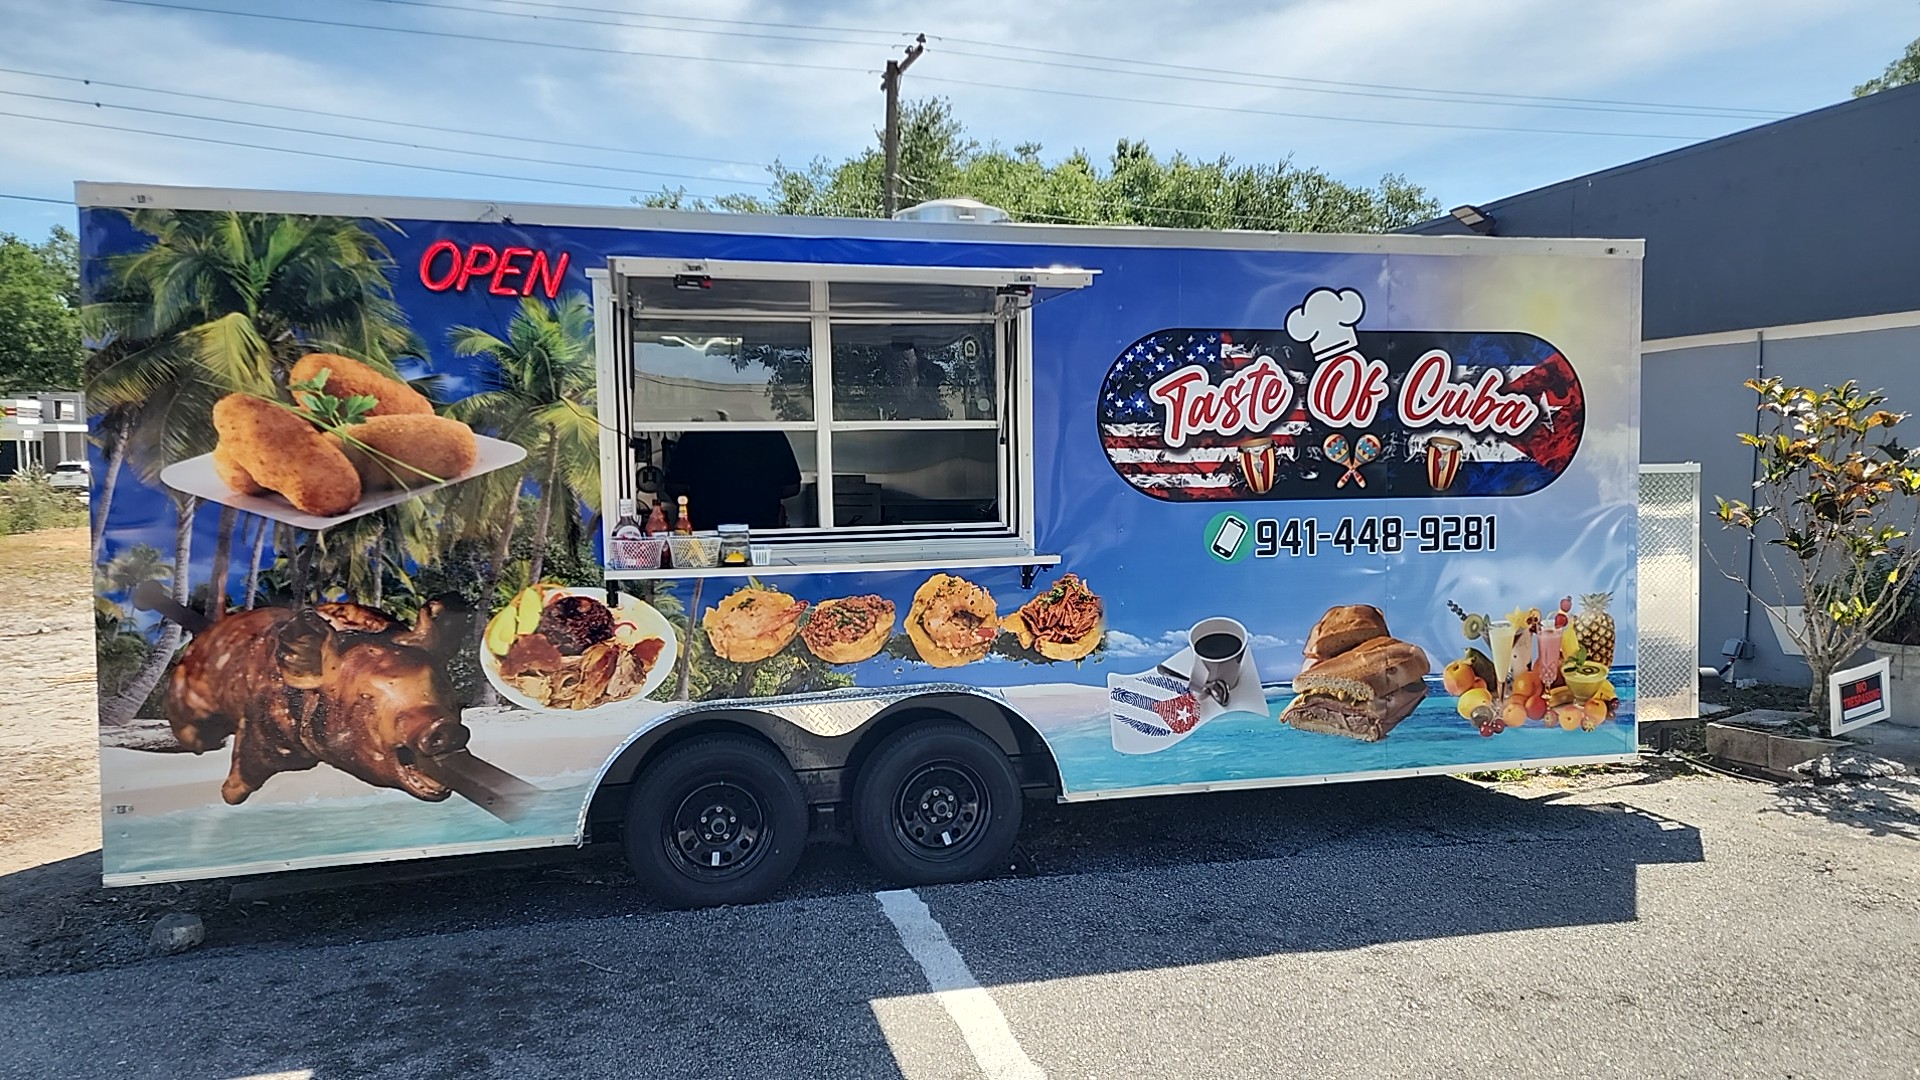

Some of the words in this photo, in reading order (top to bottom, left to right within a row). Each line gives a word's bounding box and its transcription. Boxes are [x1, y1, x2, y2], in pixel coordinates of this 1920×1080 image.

[419, 239, 570, 299] OPEN
[1151, 357, 1292, 446] Taste
[1310, 354, 1387, 426] Of
[1400, 352, 1537, 433] Cuba
[1256, 516, 1497, 557] 941-448-9281
[1843, 688, 1881, 710] TRESPASSING
[1856, 681, 1867, 694] NO
